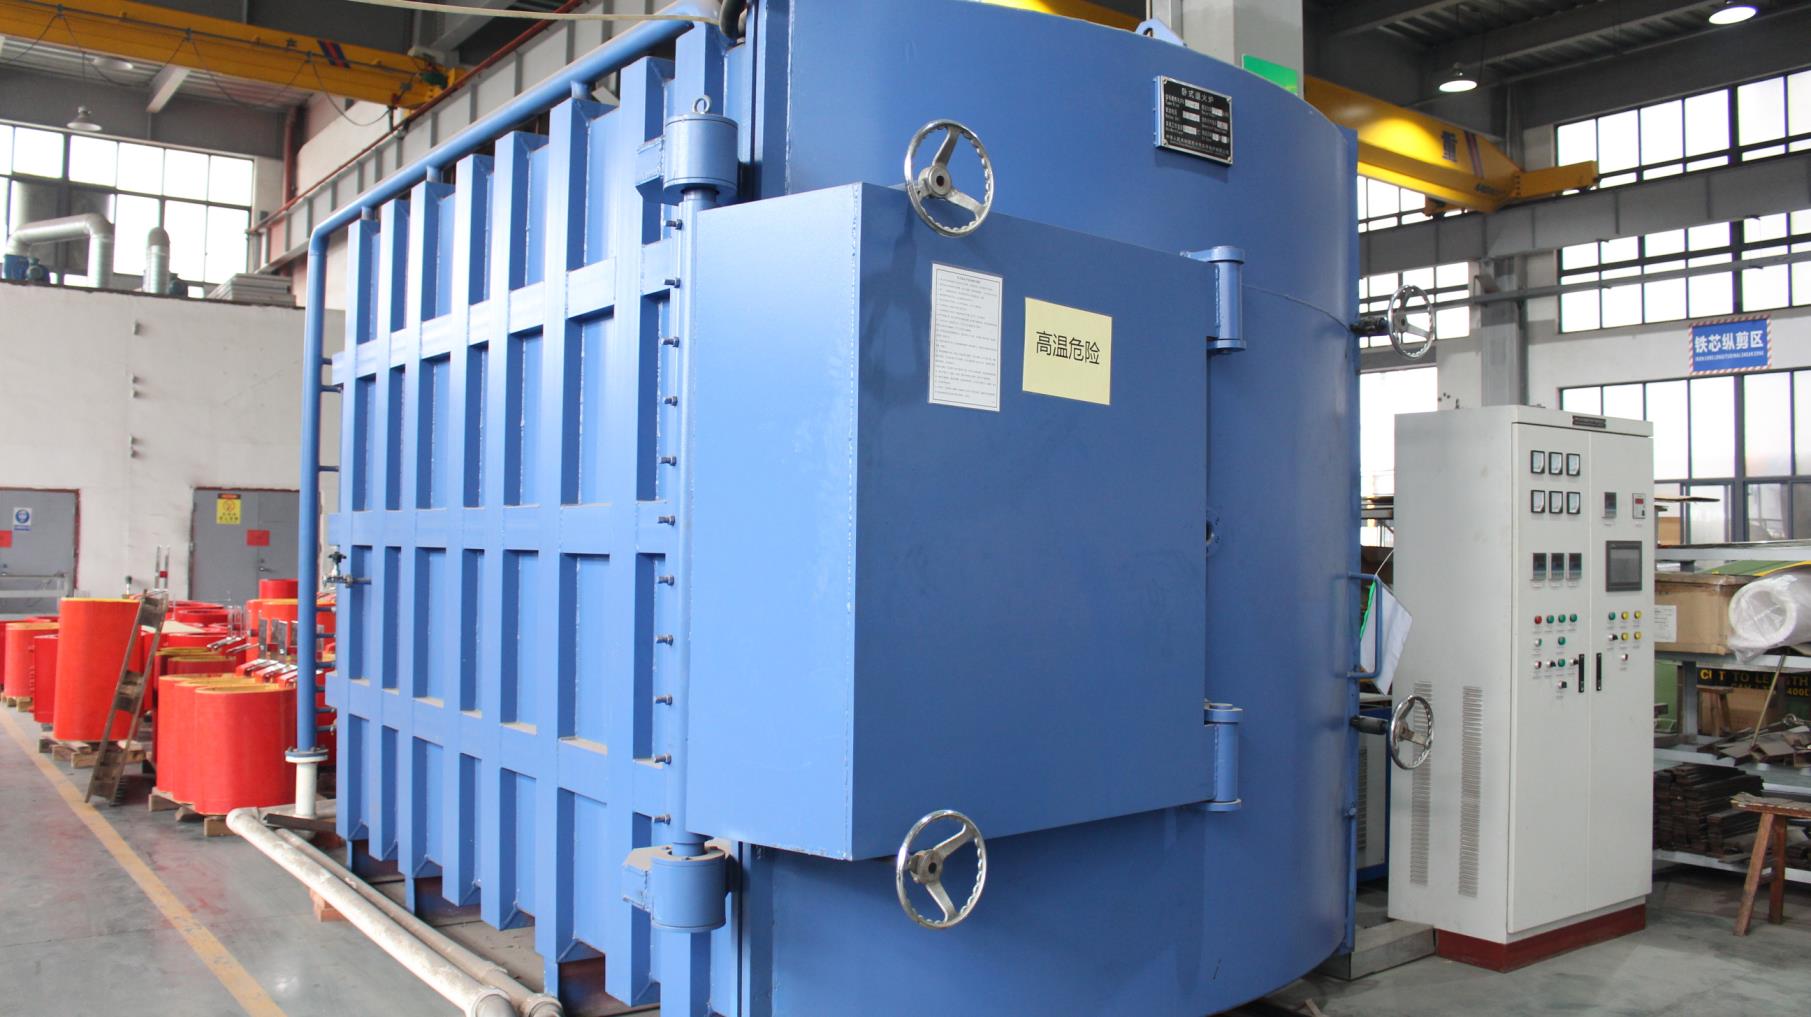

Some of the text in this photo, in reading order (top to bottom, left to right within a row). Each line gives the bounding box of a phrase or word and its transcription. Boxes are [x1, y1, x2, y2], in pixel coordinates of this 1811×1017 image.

[1036, 331, 1100, 365] 高温危险
[1695, 330, 1763, 353] 铁芯纵剪区
